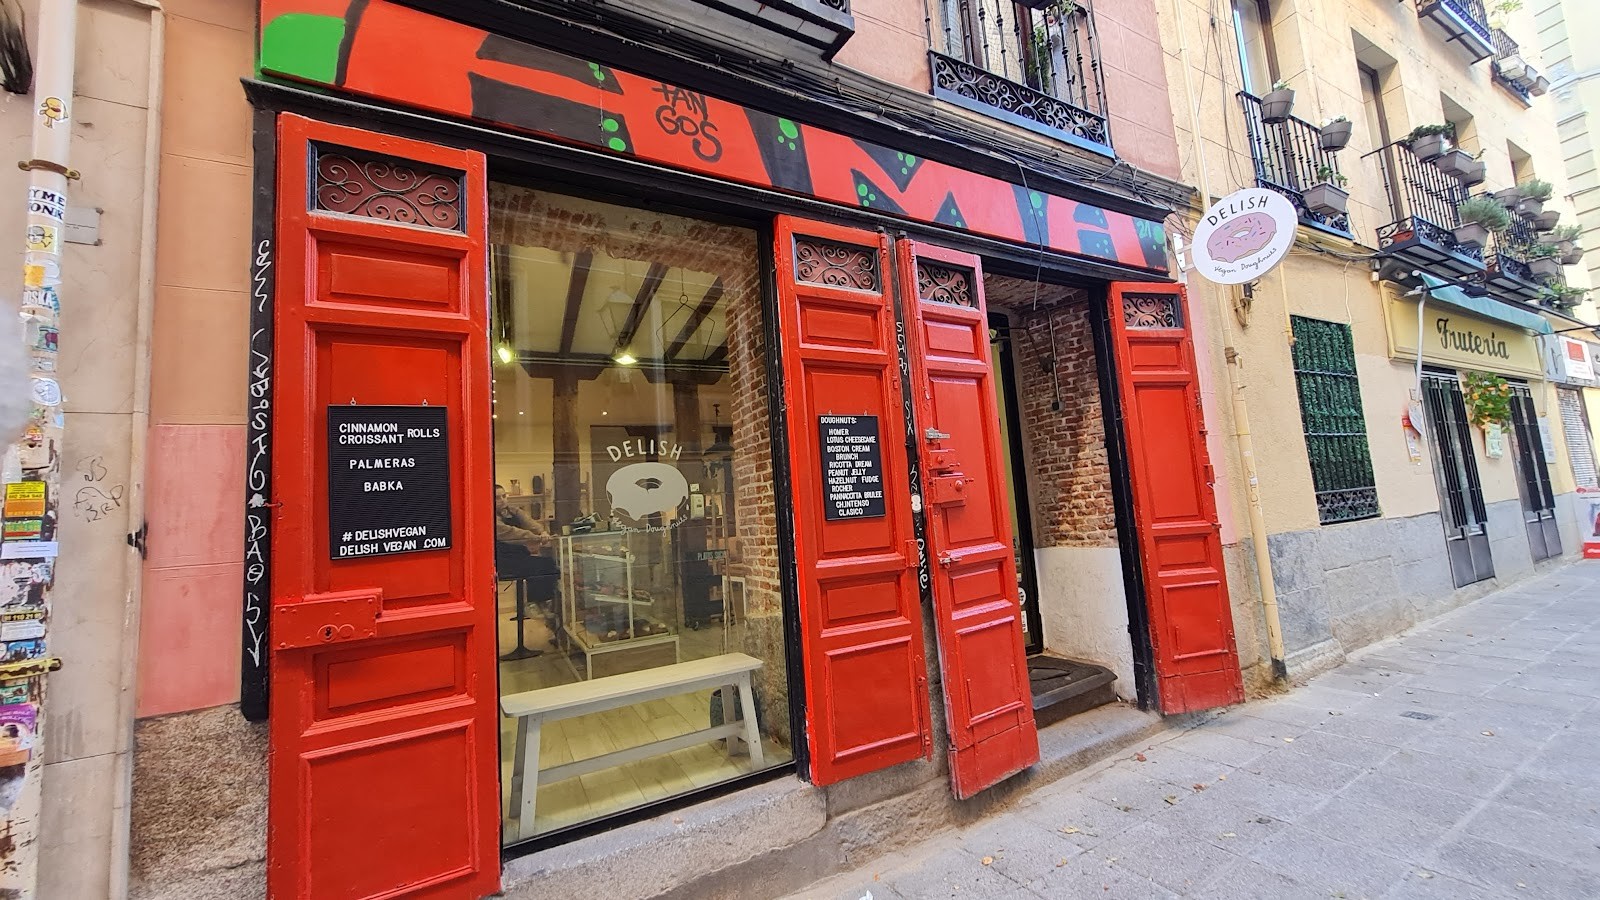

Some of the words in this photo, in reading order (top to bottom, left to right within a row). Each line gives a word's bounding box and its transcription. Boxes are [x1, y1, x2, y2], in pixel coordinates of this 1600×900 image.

[1207, 195, 1268, 226] DELISH
[1214, 266, 1236, 277] Vegan
[1241, 248, 1276, 270] Doughnuts
[339, 423, 397, 432] CINNAMON
[408, 428, 440, 438] ROLLS
[339, 434, 404, 444] CROISSANT
[607, 439, 682, 462] DELISH
[350, 458, 415, 469] PALMERAS
[364, 481, 403, 492] BABKA
[830, 492, 862, 500] PANNACOTTA
[839, 508, 863, 516] CLASICO
[340, 543, 378, 556] DELISH
